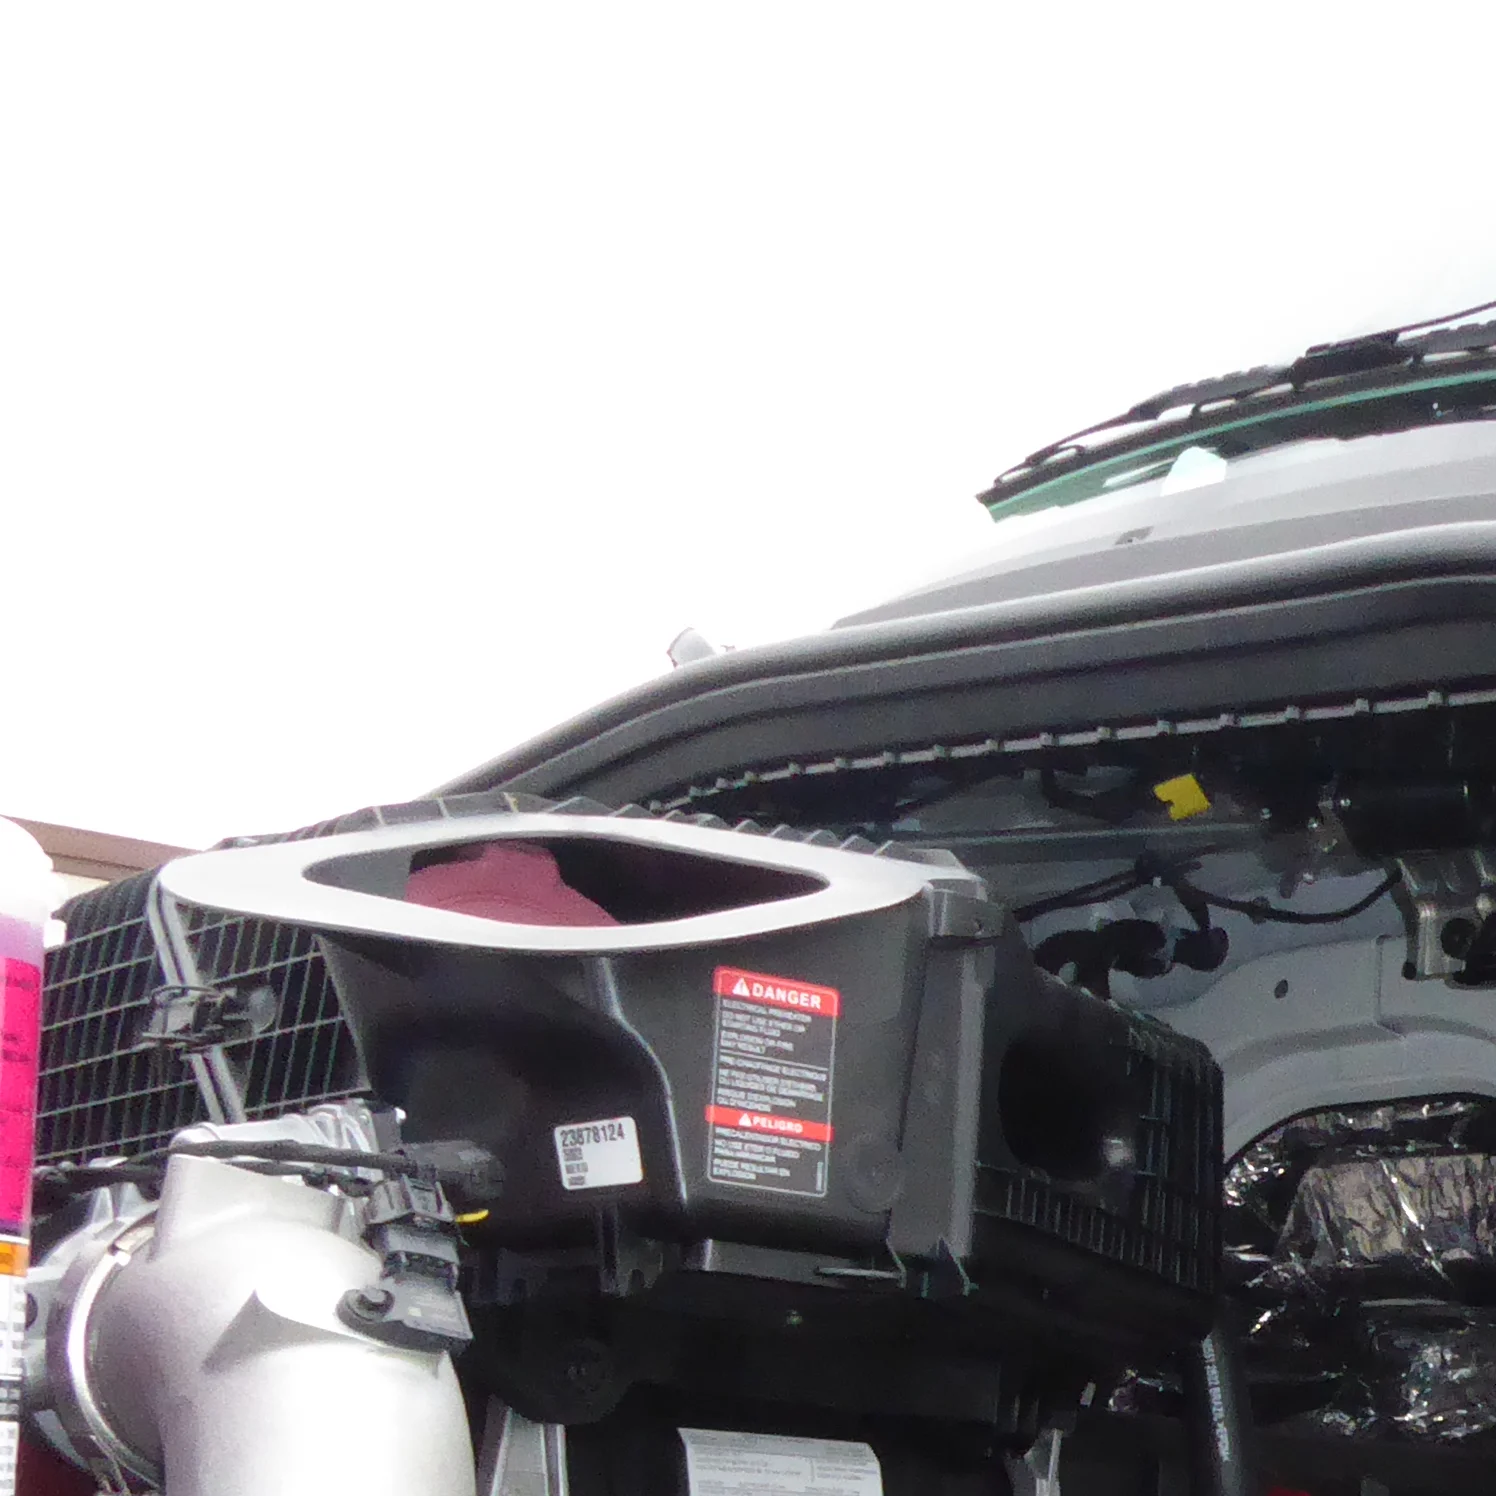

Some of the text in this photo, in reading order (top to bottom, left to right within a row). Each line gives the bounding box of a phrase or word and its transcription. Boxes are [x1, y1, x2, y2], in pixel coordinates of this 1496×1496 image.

[752, 982, 821, 1009] DANGER
[560, 1123, 625, 1148] 23878124
[753, 1115, 804, 1134] PELIGRO
